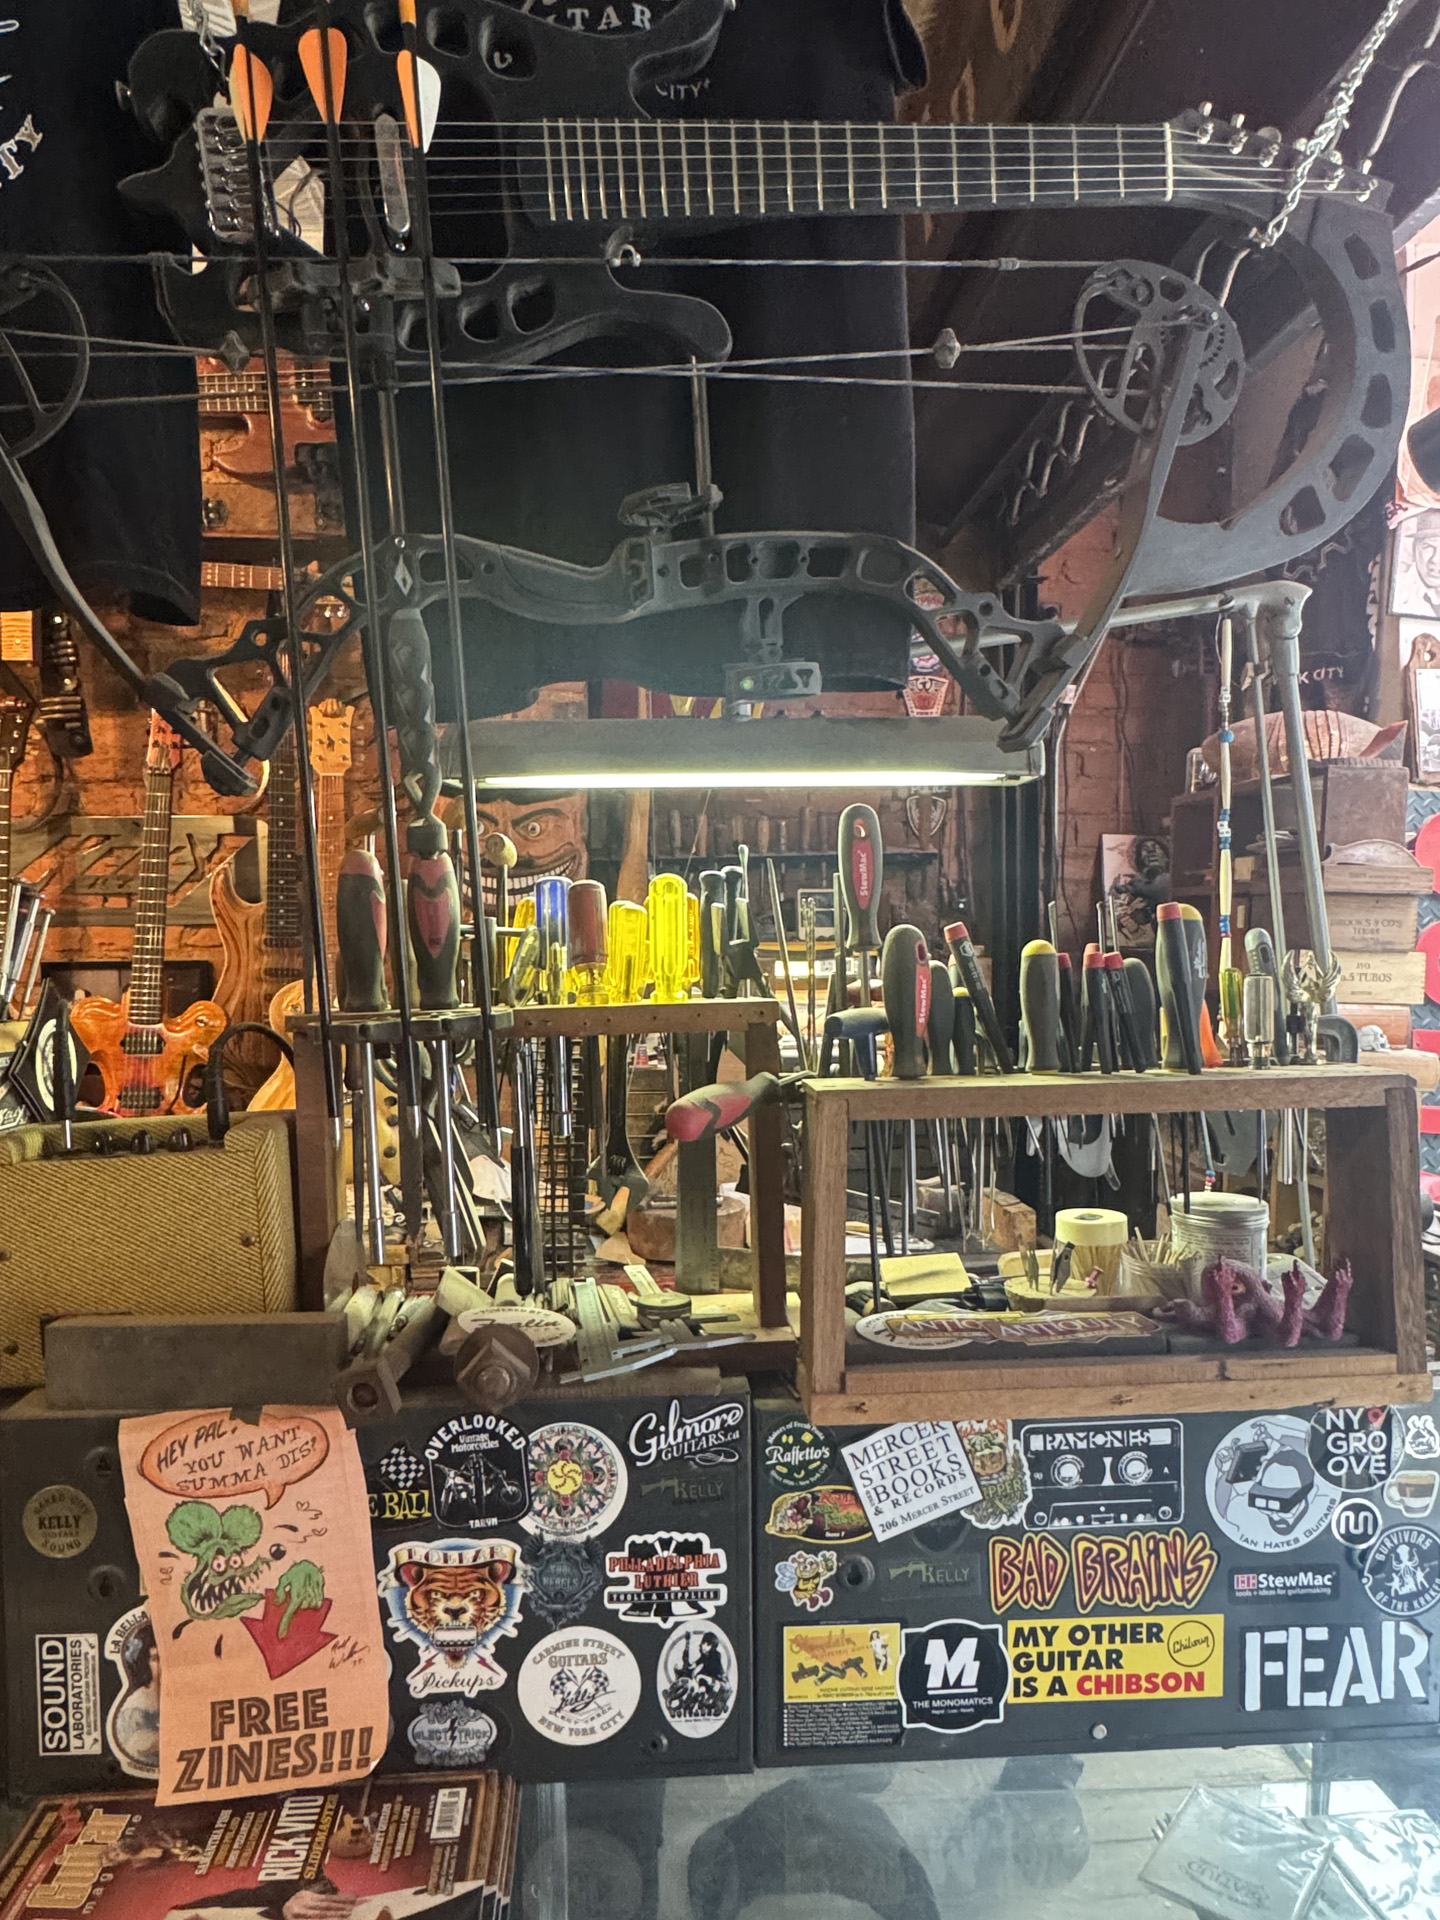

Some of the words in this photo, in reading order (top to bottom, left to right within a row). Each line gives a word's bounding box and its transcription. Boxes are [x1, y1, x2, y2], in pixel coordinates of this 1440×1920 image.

[859, 850, 868, 897] StewMac
[1340, 972, 1355, 982] o.5
[1356, 973, 1392, 982] TUBOS
[918, 977, 927, 1024] StewMac
[899, 1318, 983, 1333] ANTIQ
[1000, 1315, 1142, 1337] ANTIQUITY
[1325, 1407, 1364, 1430] NY
[425, 1414, 527, 1460] OVERLOOKED
[451, 1440, 500, 1453] Motorcycles
[459, 1432, 490, 1444] Vintage
[629, 1399, 744, 1467] Gilmore
[661, 1430, 740, 1461] GUITARS.ca
[849, 1421, 948, 1470] MERCER
[1046, 1429, 1150, 1450] RAMONES
[1326, 1431, 1387, 1454] GRO
[157, 1434, 189, 1473] HEY
[184, 1451, 226, 1475] YOU
[235, 1425, 300, 1461] WANT
[765, 1445, 830, 1466] Raffetto's
[859, 1433, 953, 1488] STREET
[176, 1462, 268, 1492] SUMMA
[276, 1436, 318, 1470] DIS?
[1326, 1454, 1387, 1476] OVE
[675, 1480, 724, 1499] KELLY
[872, 1453, 962, 1505] BOOKS
[873, 1505, 884, 1516] &
[891, 1470, 967, 1509] RECORDS
[38, 1515, 80, 1530] KELLY
[879, 1518, 899, 1534] 206
[900, 1502, 940, 1525] MERCER
[940, 1486, 976, 1507] STREET
[1374, 1530, 1433, 1562] SURVIVORS
[609, 1553, 720, 1573] PHILADELPHIA
[922, 1562, 970, 1584] KELLY
[989, 1532, 1069, 1615] BAD
[1071, 1527, 1218, 1614] BRAINS
[635, 1572, 699, 1589] LUTHIER
[1235, 1589, 1252, 1597] tools
[1258, 1588, 1276, 1596] ideas
[1258, 1571, 1332, 1589] StewMac
[612, 1592, 645, 1601] TOOLS
[665, 1590, 715, 1600] SUPPLIES
[1375, 1591, 1389, 1604] OF
[1390, 1599, 1409, 1612] THE
[110, 1639, 122, 1654] LA
[116, 1610, 149, 1640] BELLA
[1012, 1625, 1059, 1648] MY
[1068, 1622, 1164, 1646] OTHER
[532, 1639, 580, 1665] CARMINE
[583, 1638, 625, 1659] STREET
[548, 1653, 608, 1669] GUITARS
[1013, 1648, 1124, 1672] GUITAR
[1244, 1620, 1429, 1712] FEAR
[42, 1640, 67, 1749] SOUND
[70, 1639, 85, 1750] LABORATORIES
[413, 1671, 499, 1695] Pickups
[1013, 1677, 1038, 1698] IS
[1046, 1677, 1069, 1697] A
[1076, 1671, 1205, 1697] CHIBSON
[210, 1687, 329, 1743] FREE
[912, 1700, 930, 1709] THE
[932, 1697, 993, 1708] MONOMATICS
[538, 1716, 565, 1734] NEW
[569, 1727, 597, 1737] YORK
[600, 1710, 625, 1731] CITY
[172, 1726, 374, 1794] ZINES!!!
[274, 1795, 324, 1835] VITO
[304, 1794, 339, 1880] SLIDEMASTER
[82, 1815, 142, 1914] magne
[257, 1837, 312, 1881] RICK
